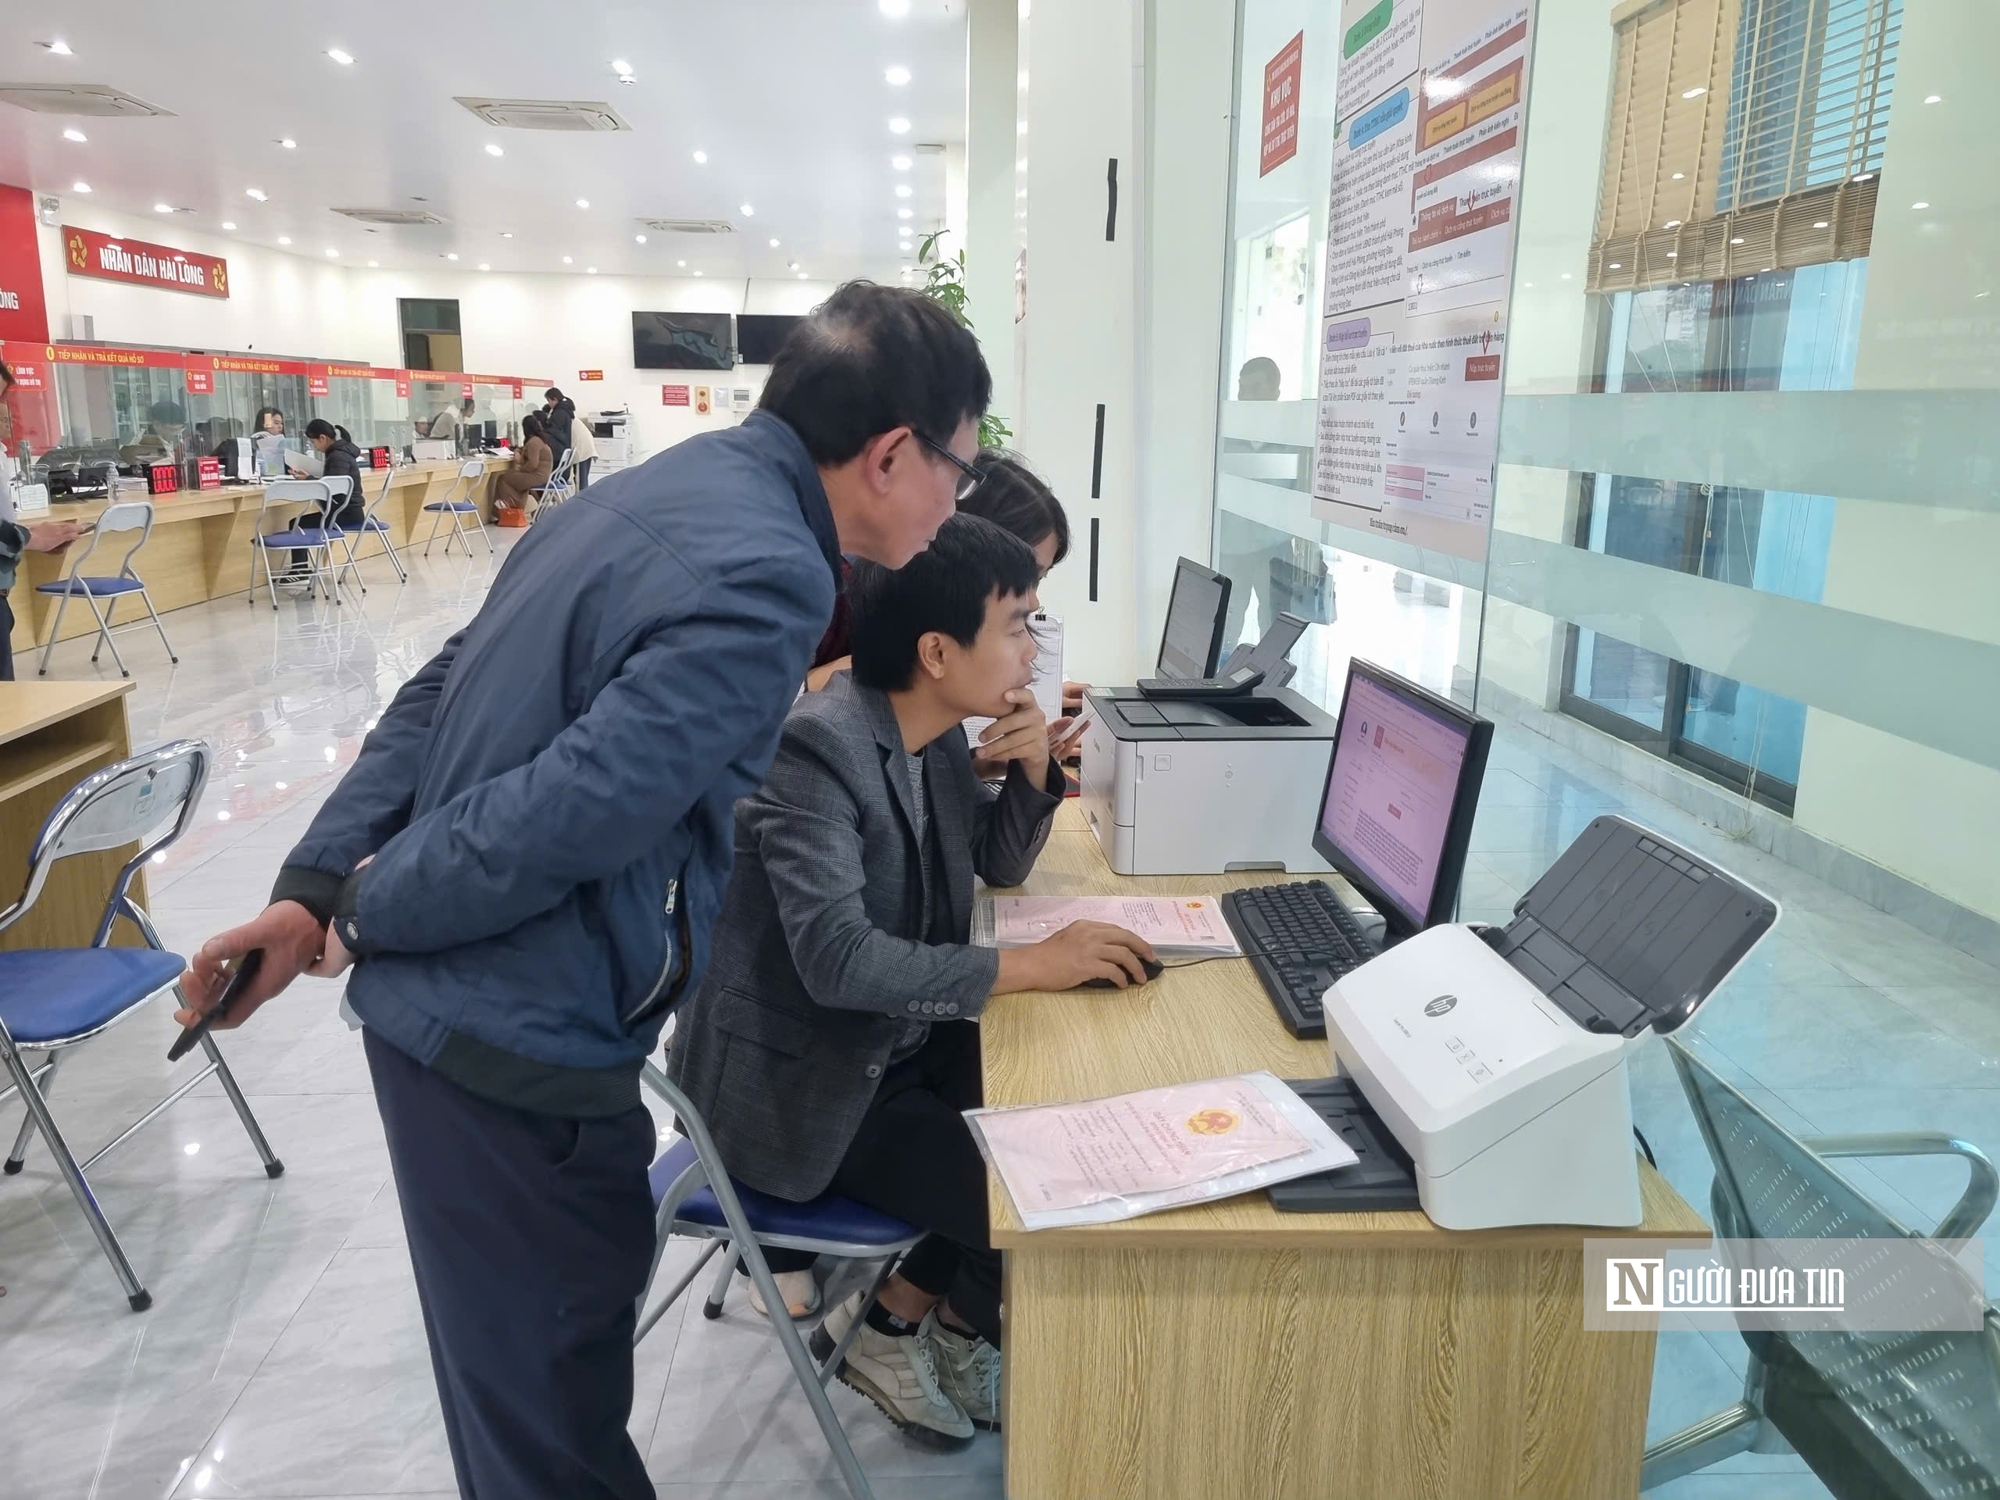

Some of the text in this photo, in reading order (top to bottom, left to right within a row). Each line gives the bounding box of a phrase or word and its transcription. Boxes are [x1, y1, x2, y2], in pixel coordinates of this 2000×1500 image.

[99, 247, 204, 286] NHÂN DÂN HÀI LÒNG
[58, 350, 71, 360] TIẾP
[72, 352, 86, 362] NHẬN
[87, 352, 95, 361] VÀ
[96, 352, 106, 361] TRẢ
[107, 352, 117, 362] KẾT
[1424, 995, 1457, 1017] hp
